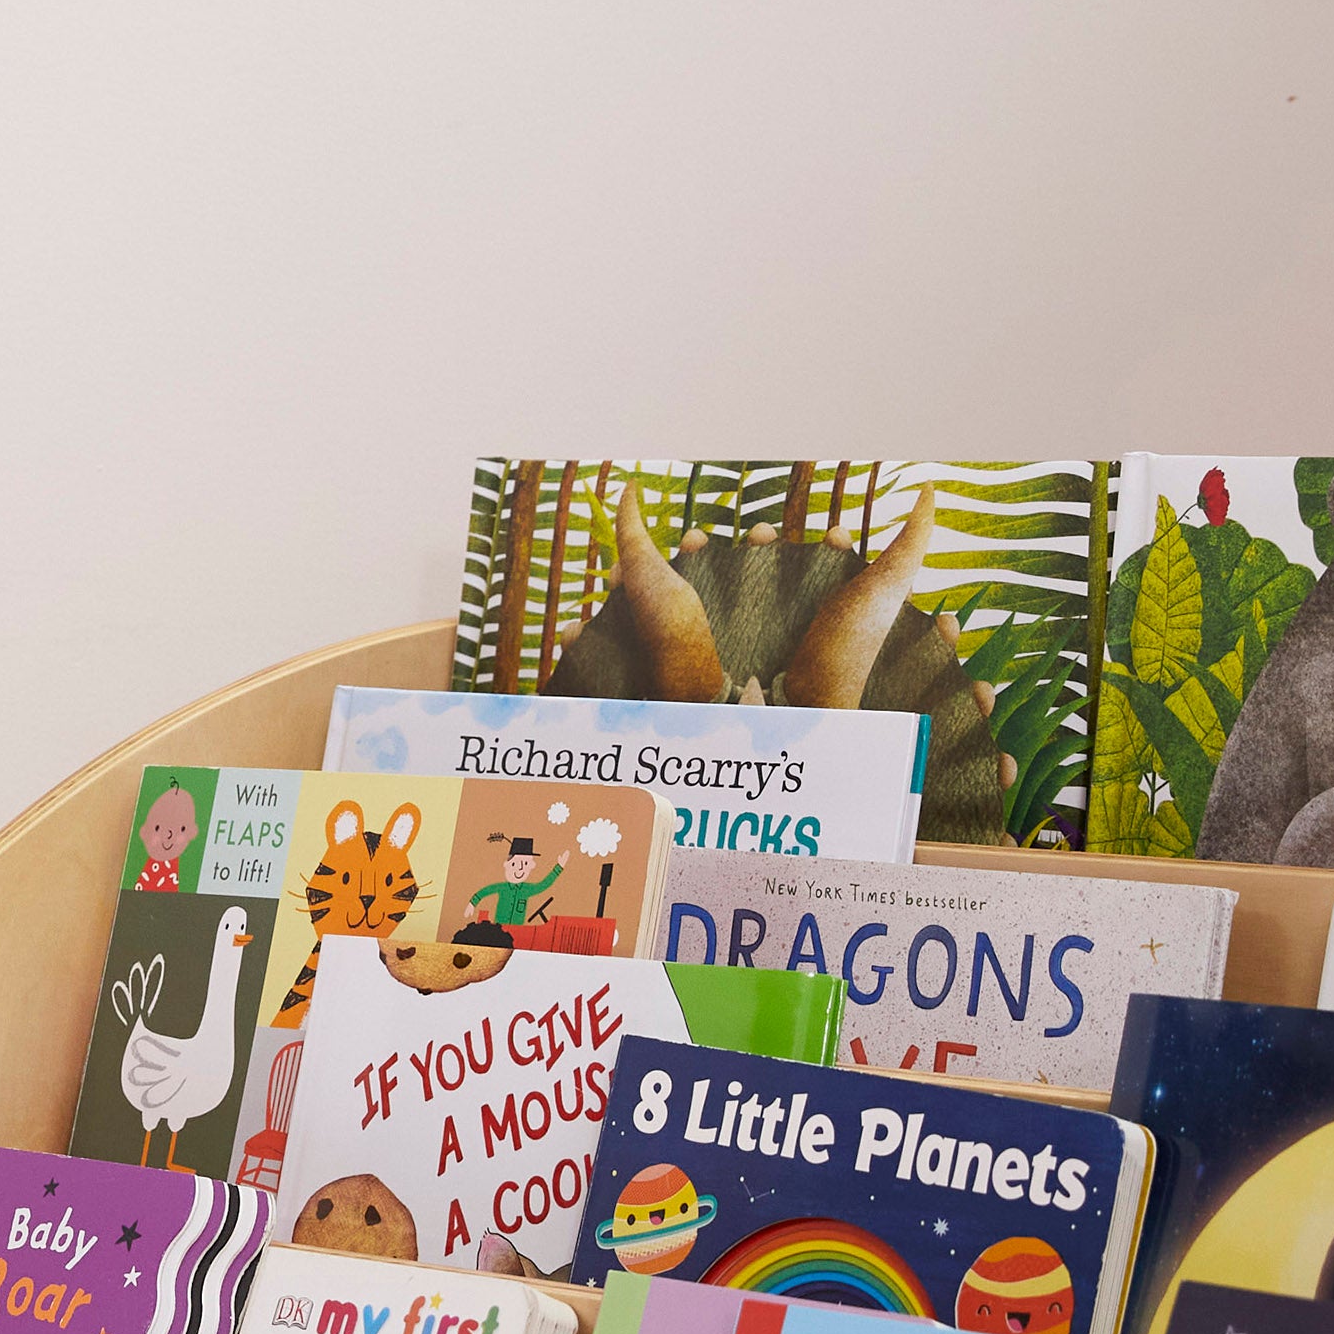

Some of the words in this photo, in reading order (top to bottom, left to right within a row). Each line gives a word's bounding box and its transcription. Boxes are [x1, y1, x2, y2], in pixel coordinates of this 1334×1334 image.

[236, 783, 278, 807] With
[455, 736, 622, 784] Richard
[634, 744, 804, 800] Scarry's
[214, 820, 285, 848] FLAPS
[213, 862, 230, 881] to
[238, 859, 271, 883] lift!
[906, 891, 987, 911] bestseller
[666, 902, 1094, 1038] DRAGONS
[353, 1051, 400, 1130] IF
[410, 1017, 493, 1102] YOU
[507, 983, 623, 1072] GIVE
[437, 1115, 464, 1177] A
[481, 1062, 614, 1158] MOUS
[631, 1069, 673, 1134] 8
[683, 1078, 835, 1165] Little
[854, 1107, 1090, 1212] Planets
[444, 1198, 471, 1256] A
[493, 1153, 593, 1234] COO
[7, 1206, 97, 1270] Baby
[278, 1296, 305, 1324] DK
